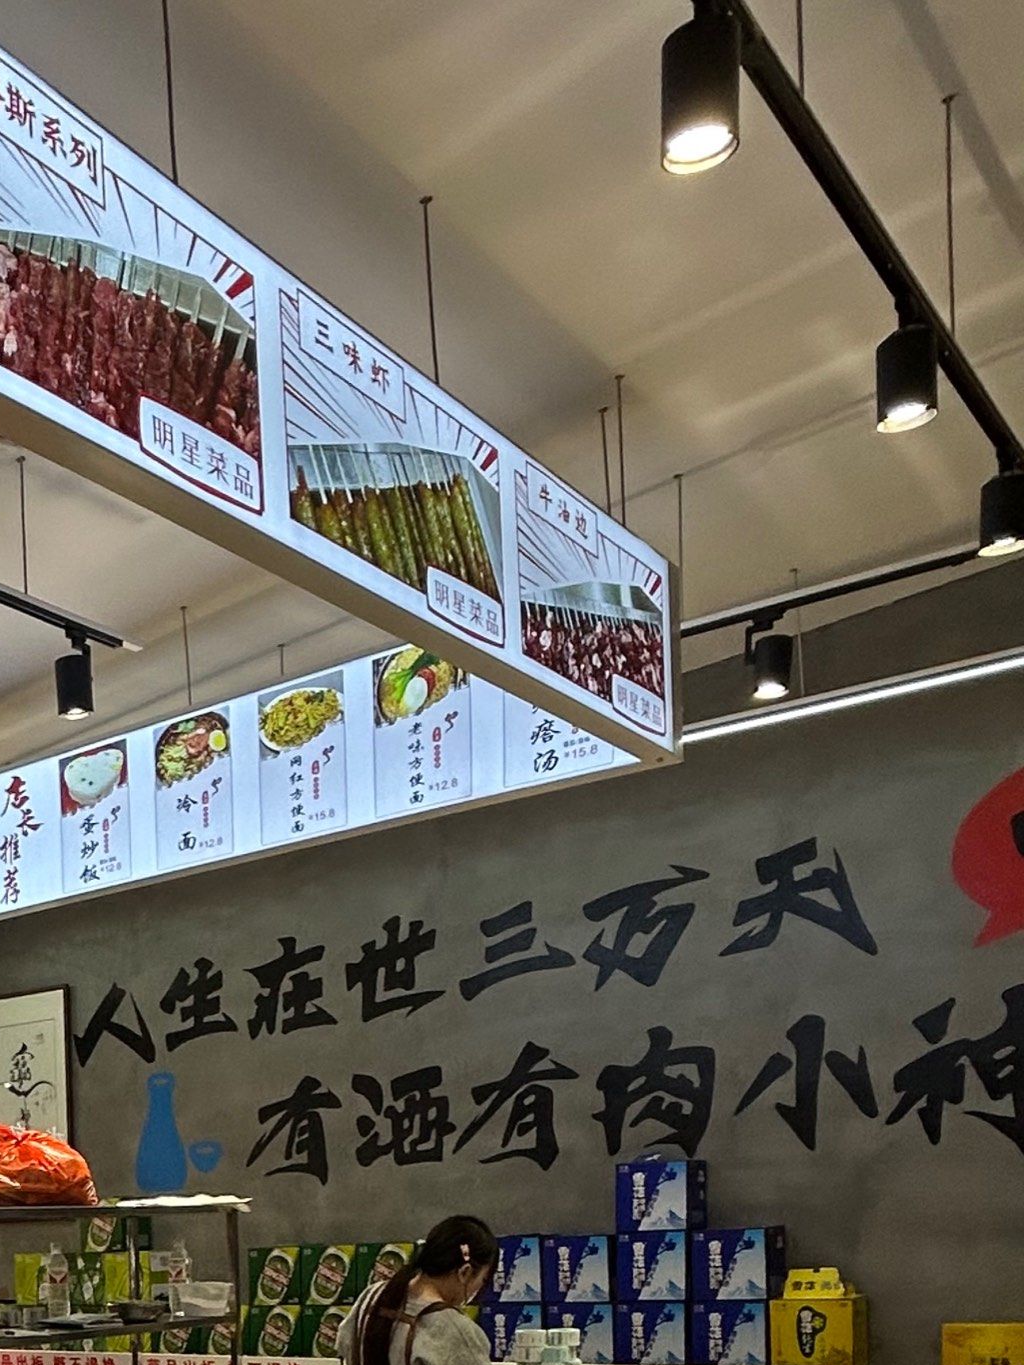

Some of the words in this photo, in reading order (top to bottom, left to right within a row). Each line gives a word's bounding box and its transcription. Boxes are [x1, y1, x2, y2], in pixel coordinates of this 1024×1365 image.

[313, 319, 391, 396] 三味虾
[151, 413, 255, 501] 明星菜品
[538, 488, 590, 541] 牛油边
[433, 579, 500, 637] 明星菜品
[530, 704, 561, 773] 瘩汤
[616, 686, 665, 727] 明星菜品
[79, 813, 101, 884] 蛋炒饭
[176, 794, 198, 851] 冷面
[72, 836, 879, 1068] 人生在世三万天
